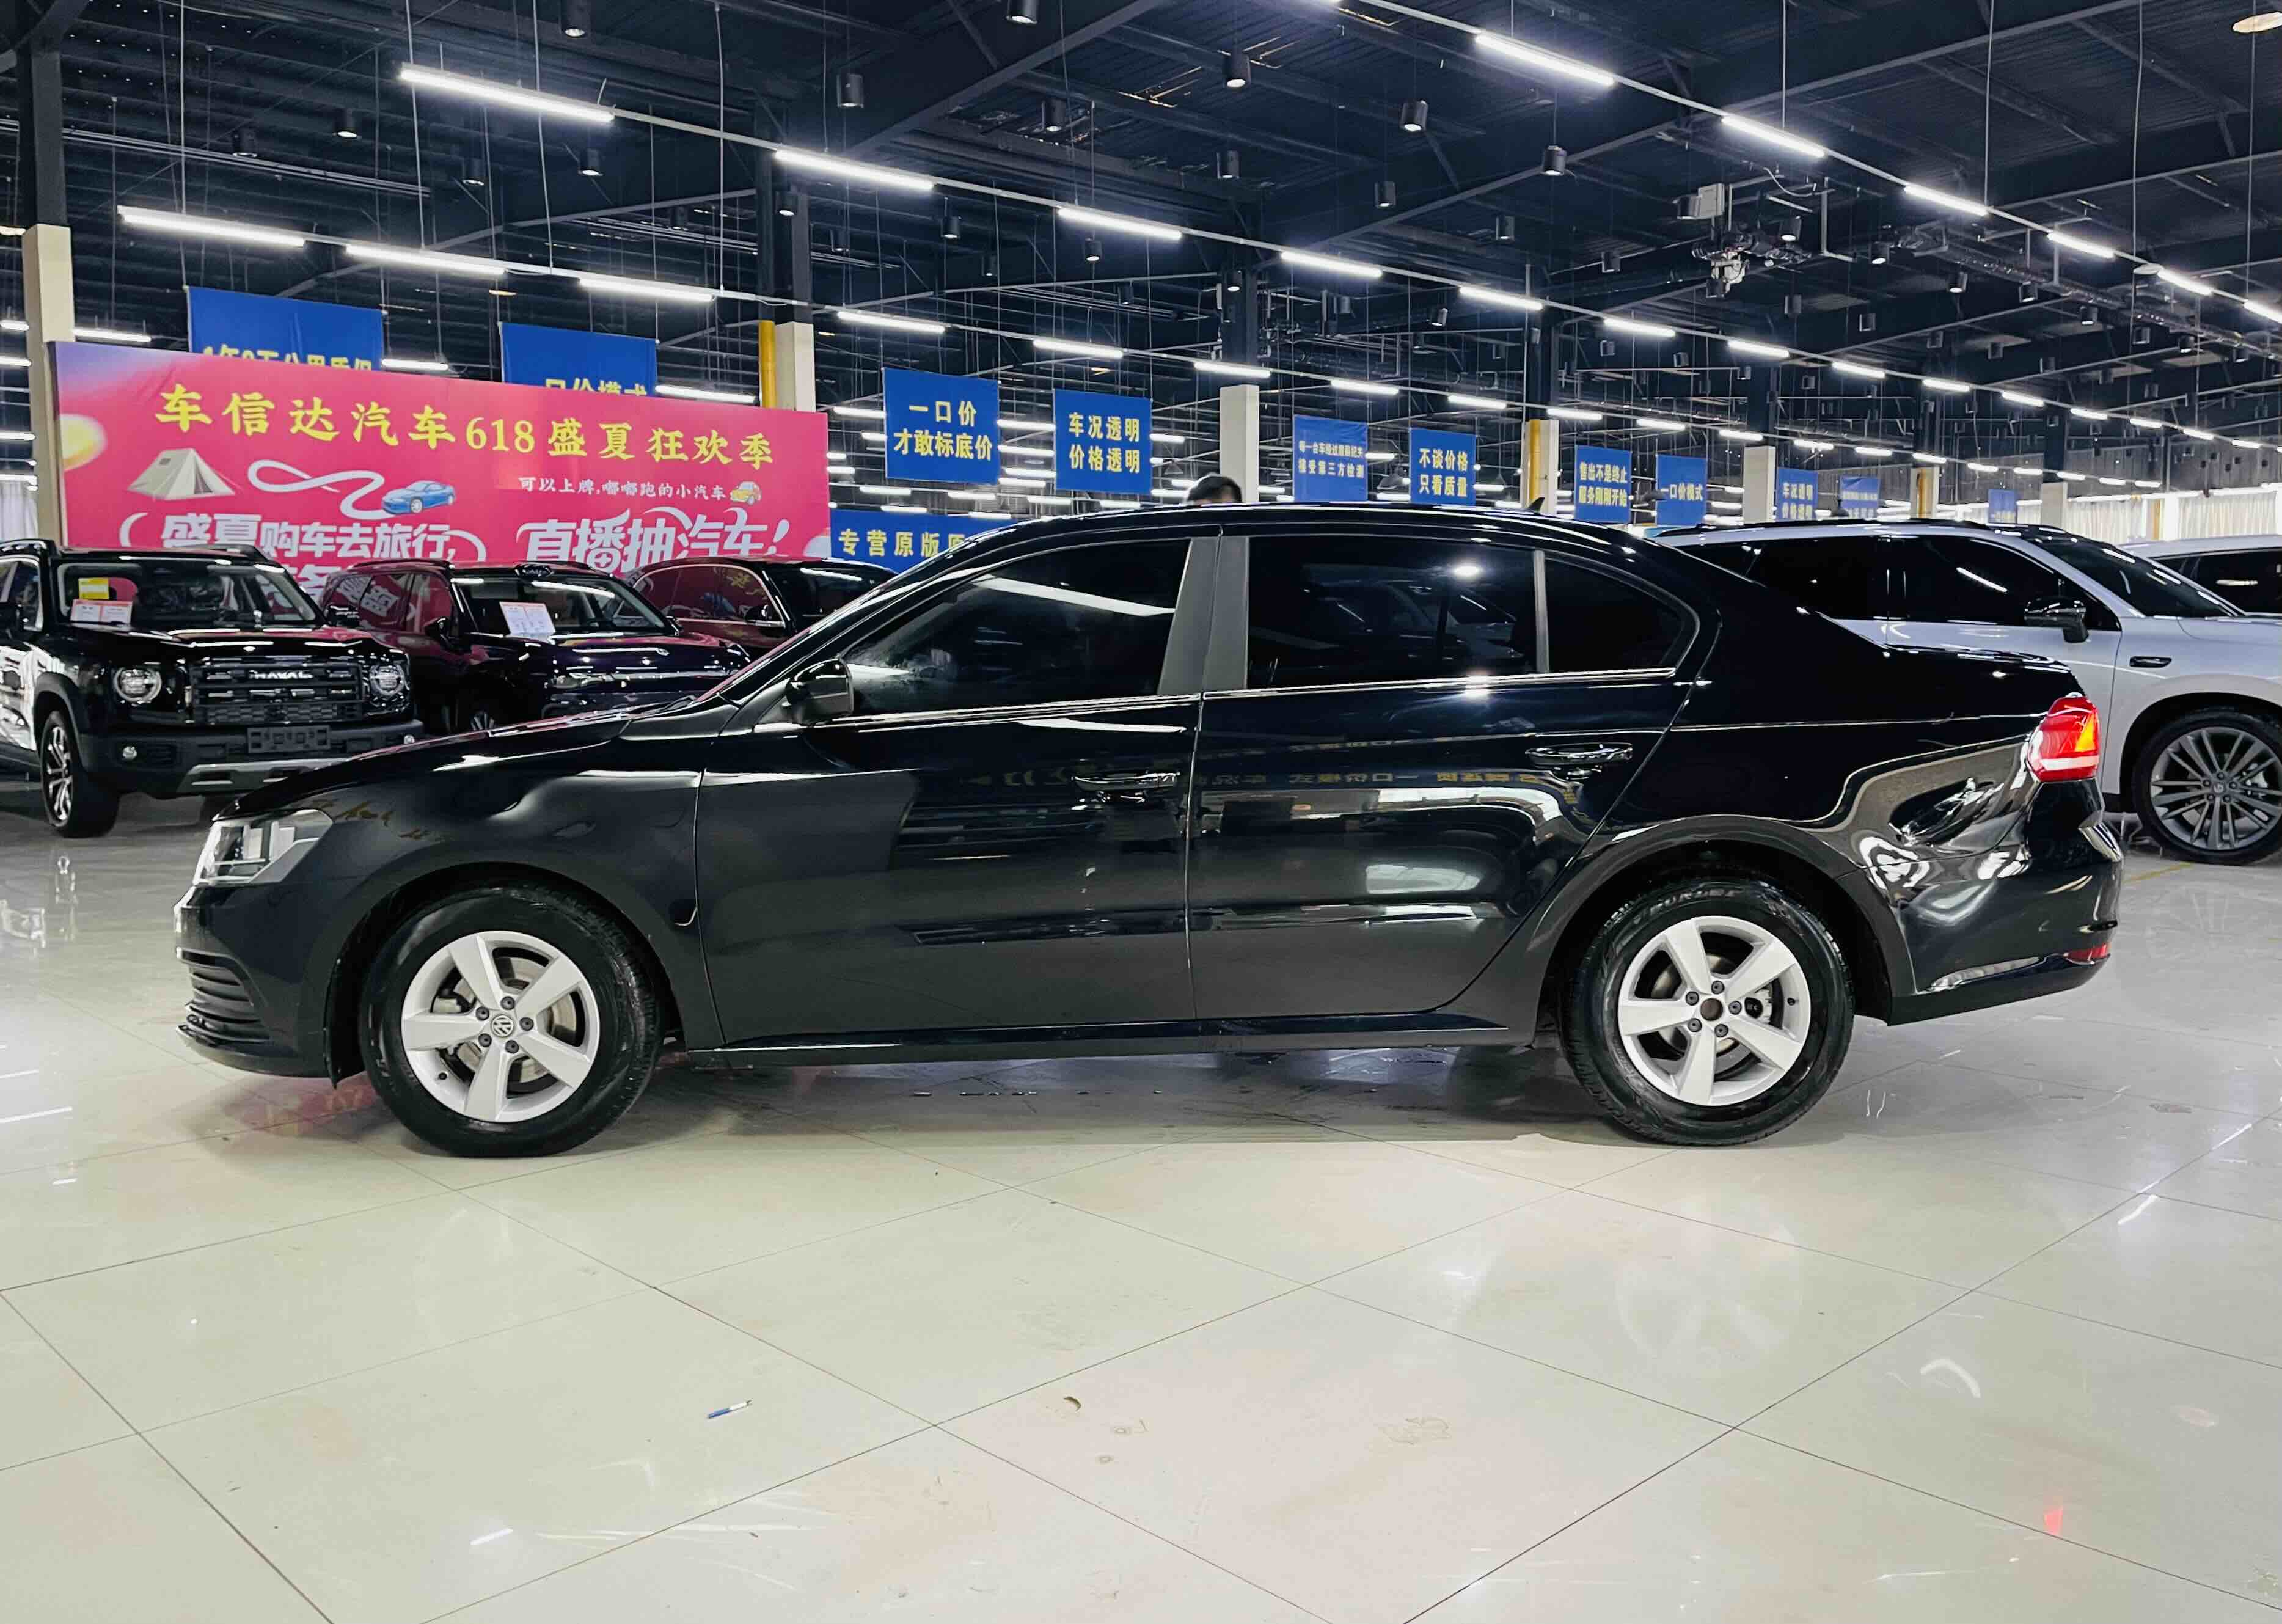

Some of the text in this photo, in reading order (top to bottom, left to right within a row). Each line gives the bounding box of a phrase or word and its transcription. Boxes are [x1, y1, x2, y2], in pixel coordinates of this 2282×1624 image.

[909, 400, 977, 427] 一口价
[155, 384, 773, 470] 车信达汽车618盛夏狂欢季
[1069, 411, 1139, 442] 车况透明
[894, 428, 993, 461] 才敢标底价
[1069, 444, 1140, 474] 价格透明
[1419, 448, 1468, 472] 不谈价格
[1579, 461, 1628, 484] 售出不是终止
[1419, 474, 1468, 497] 只看质量
[1578, 486, 1627, 507] 服务刚刚开始
[1660, 482, 1703, 501] 一口价模式
